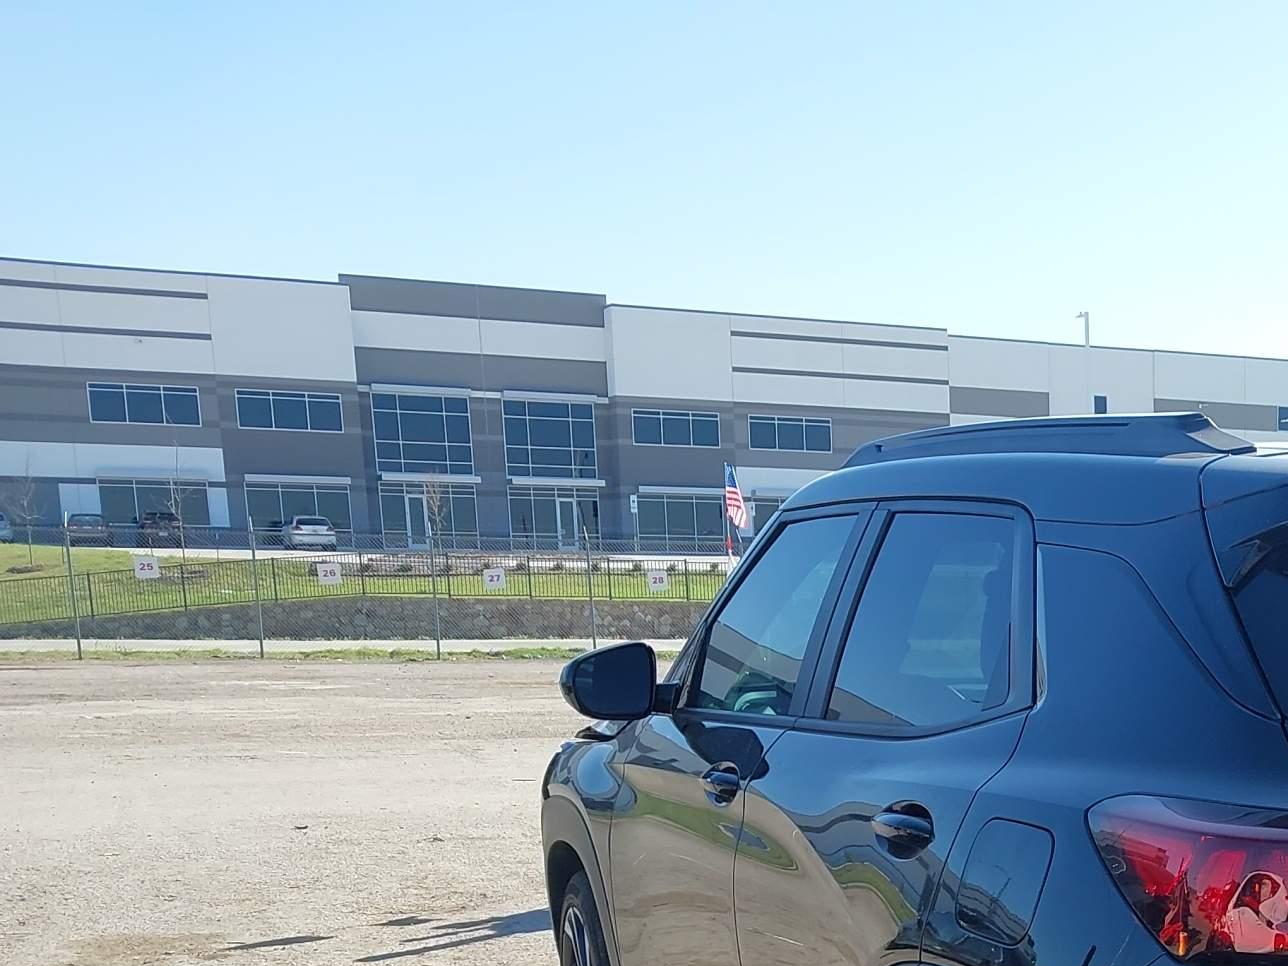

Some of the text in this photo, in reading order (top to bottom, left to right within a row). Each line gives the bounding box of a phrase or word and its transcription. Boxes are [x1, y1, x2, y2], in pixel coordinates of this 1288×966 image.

[139, 561, 154, 571] 25
[322, 568, 336, 578] 26
[487, 573, 501, 583] 27
[652, 575, 664, 585] 28
